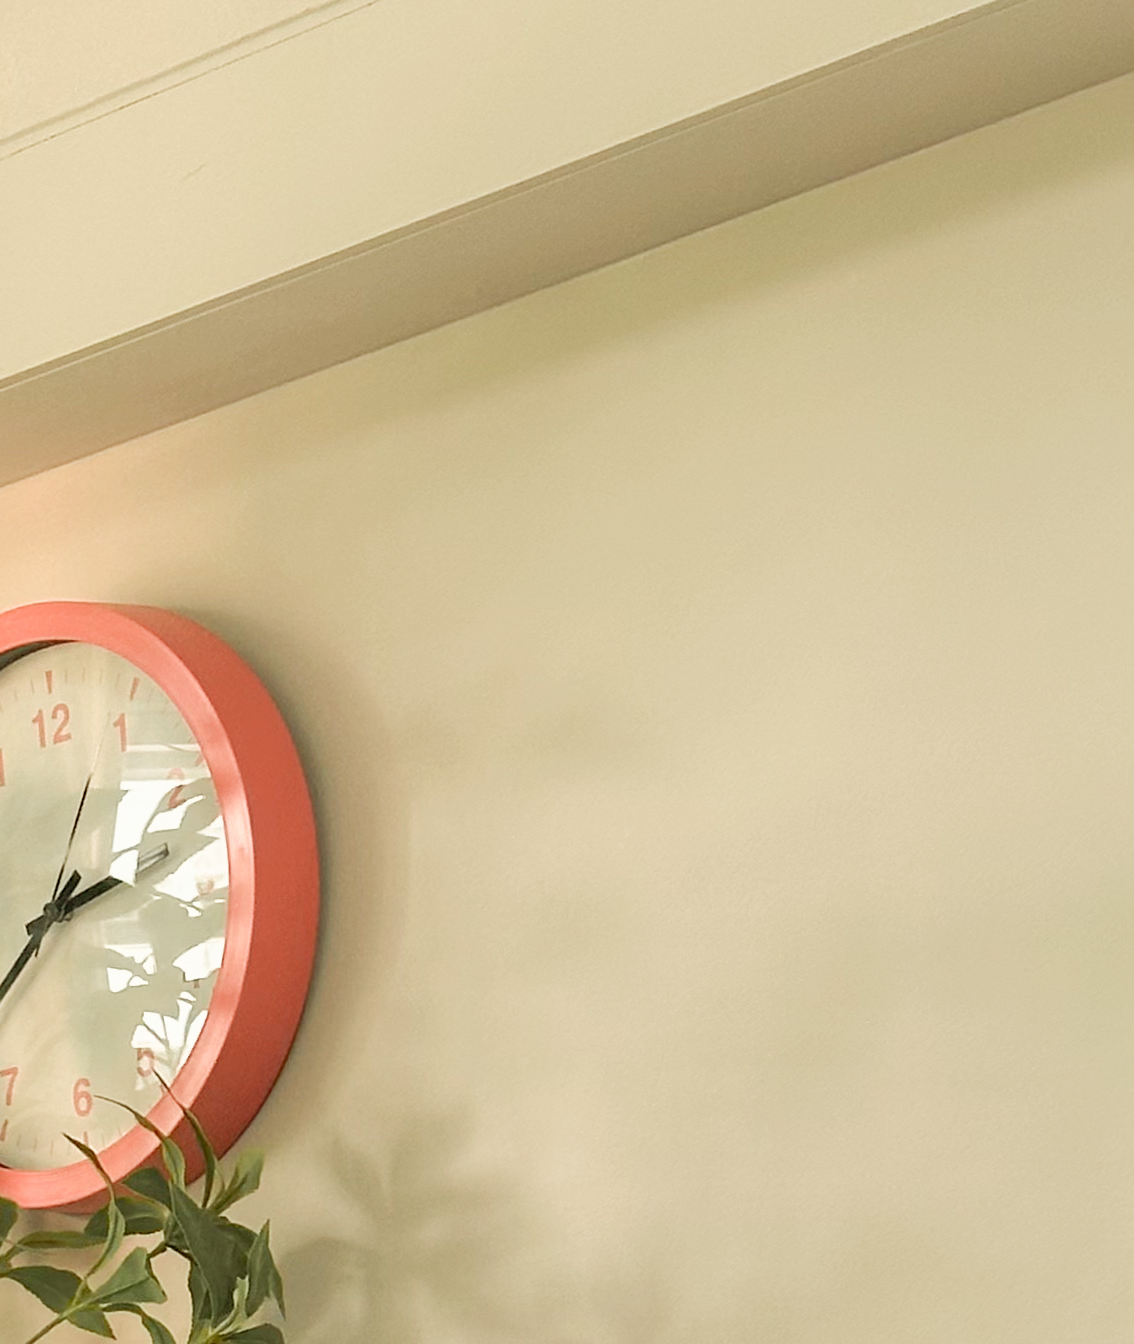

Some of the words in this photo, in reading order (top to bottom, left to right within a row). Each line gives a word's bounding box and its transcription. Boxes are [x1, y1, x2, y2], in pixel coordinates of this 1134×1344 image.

[32, 703, 71, 748] 12
[113, 712, 128, 752] 1
[0, 1067, 19, 1107] 7
[72, 1078, 92, 1117] 6
